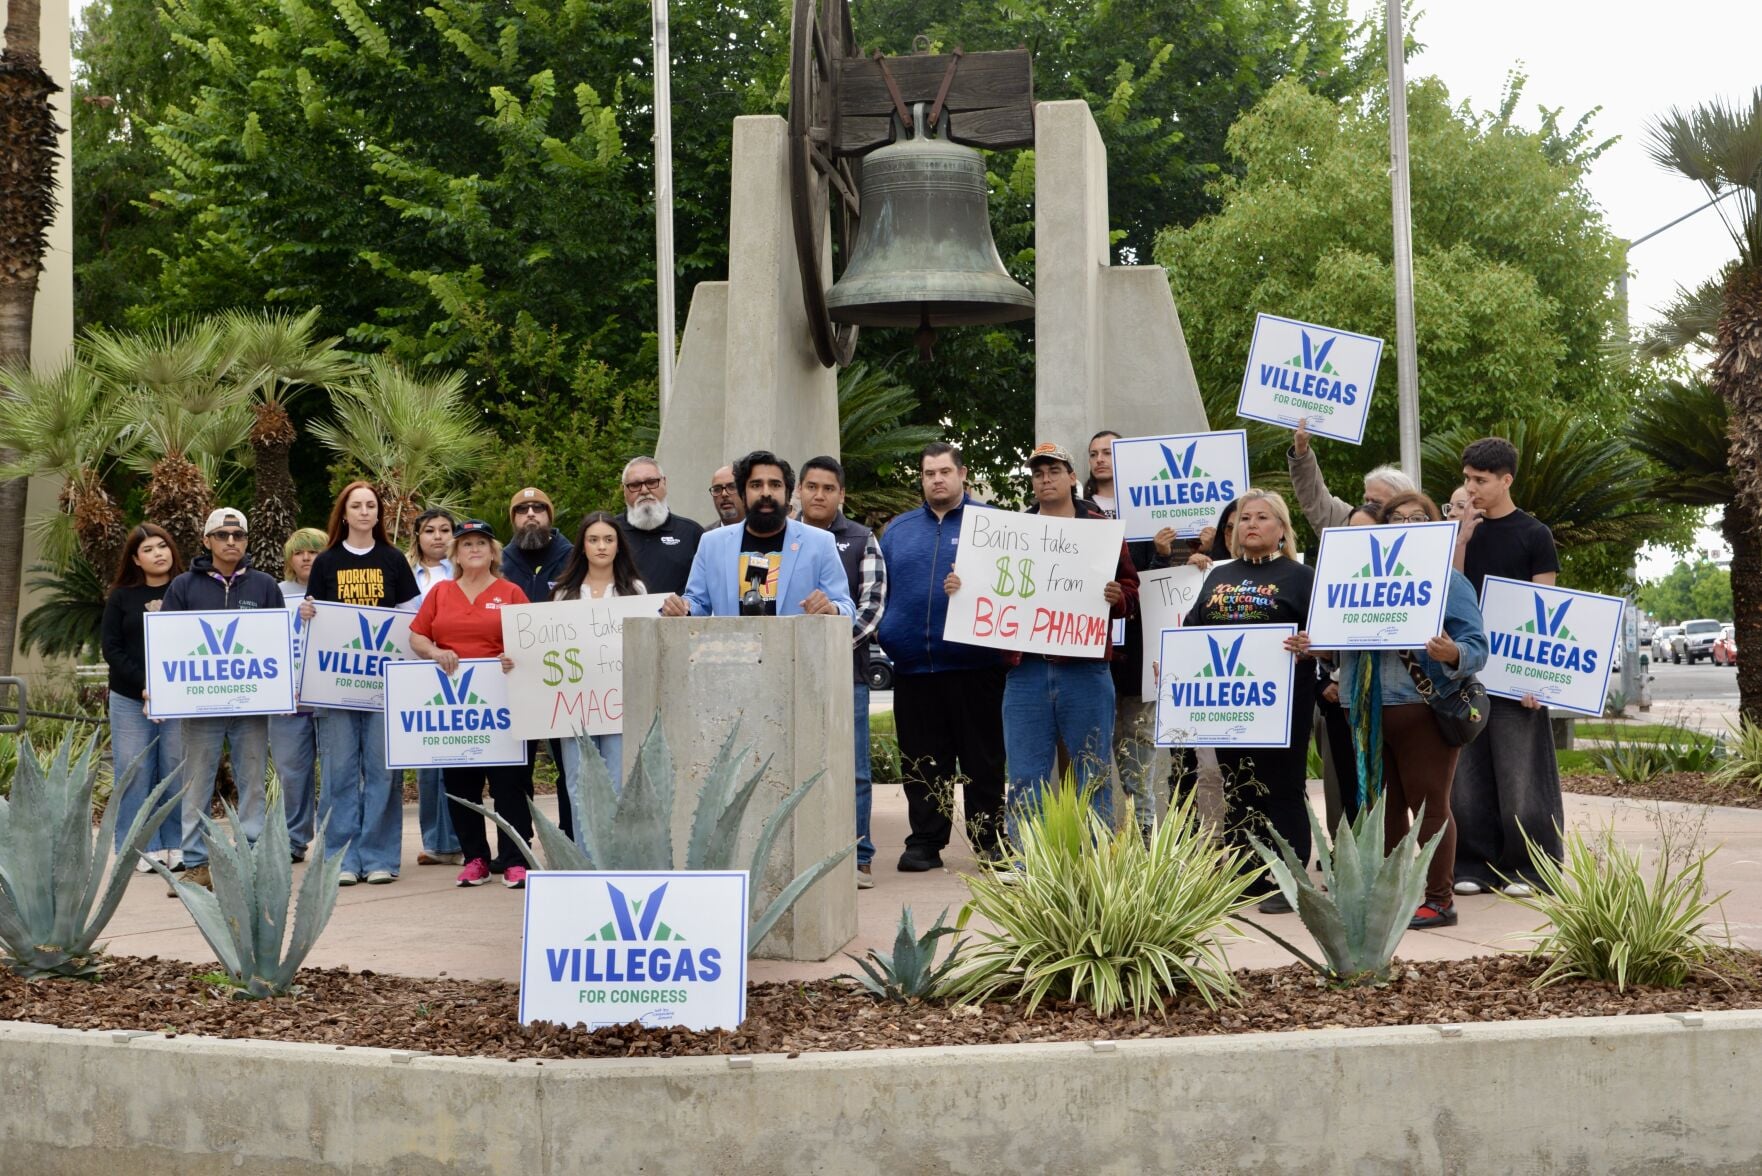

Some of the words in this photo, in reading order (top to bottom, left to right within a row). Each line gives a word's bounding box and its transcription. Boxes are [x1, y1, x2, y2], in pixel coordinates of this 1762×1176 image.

[1260, 363, 1357, 406] VILLEGAS
[1274, 393, 1290, 404] FOR
[1291, 397, 1334, 415] CONGRESS
[1129, 480, 1235, 507] VILLEGAS
[1151, 509, 1168, 519] FOR
[1170, 506, 1216, 518] CONGRESS
[971, 514, 1030, 551] Bains
[1040, 524, 1079, 555] takes
[337, 568, 384, 584] WORKING
[990, 555, 1036, 599] $$
[1047, 563, 1083, 592] from
[338, 583, 385, 600] FAMILIES
[1150, 576, 1194, 607] The
[1206, 593, 1270, 608] Mexicana
[1327, 580, 1432, 608] VILLEGAS
[517, 612, 577, 649] Bains
[973, 596, 1020, 640] BIG
[1030, 606, 1107, 646] PHARMA
[1342, 613, 1359, 623] FOR
[1361, 612, 1408, 623] CONGRESS
[318, 650, 400, 678] VILLE
[1490, 631, 1597, 673] VILLEGAS
[162, 657, 279, 683] VILLEGAS
[543, 648, 584, 687] $$
[1505, 663, 1523, 675] FOR
[1524, 667, 1572, 685] CONGRESS
[186, 685, 205, 695] FOR
[207, 684, 257, 695] CONGRESS
[336, 677, 352, 687] FOR
[1171, 681, 1277, 708] VILLEGAS
[400, 707, 512, 733] VILLEGAS
[1190, 711, 1206, 722] FOR
[1208, 711, 1255, 722] CONGRESS
[422, 736, 440, 746] FOR
[442, 735, 490, 745] CONGRESS
[546, 947, 722, 983] VILLEGAS
[579, 989, 606, 1004] FOR
[610, 989, 688, 1004] CONGRESS
